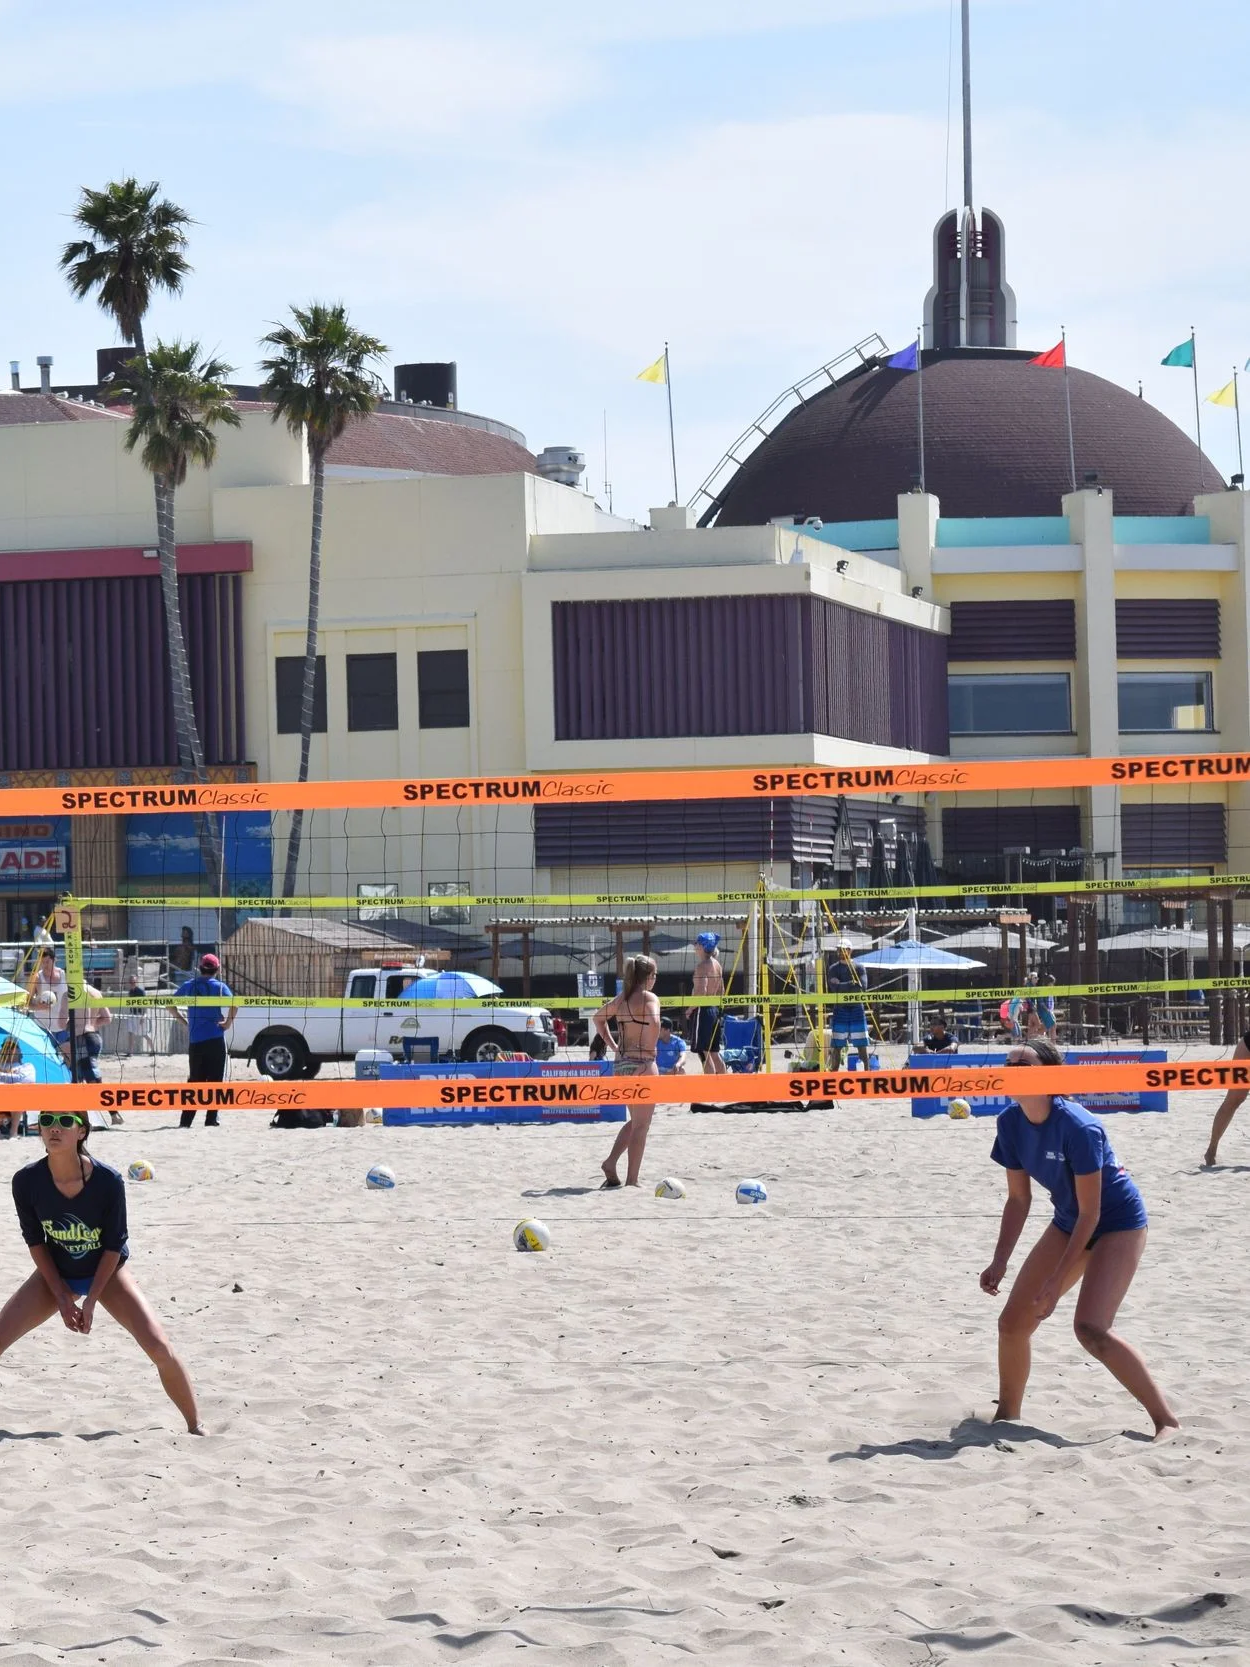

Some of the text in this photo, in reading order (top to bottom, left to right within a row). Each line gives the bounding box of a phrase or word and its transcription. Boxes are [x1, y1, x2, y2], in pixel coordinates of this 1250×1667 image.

[753, 769, 969, 790] SPECTRUM Classic
[403, 780, 615, 800] SPECTRUM Classic
[62, 789, 269, 809] SPECTRUM Classic
[1209, 874, 1250, 884] SPECTRU
[962, 885, 1011, 894] SPECTRUM
[1085, 881, 1135, 889] SPECTRUM
[839, 889, 888, 898] SPECTRUM
[356, 898, 404, 906] SPECTRUM
[476, 897, 524, 905] SPECTRUM
[596, 895, 645, 903] SPECTRUM
[1088, 985, 1138, 993] SPECTRUM
[844, 994, 893, 1002] SPECTRUM
[965, 990, 1014, 998] SPECTRUM
[126, 998, 173, 1006] SPECTRUM
[541, 1069, 578, 1077] CALIFORNIA
[1146, 1064, 1250, 1086] SPECTR
[789, 1075, 1004, 1096] SPECTRUM Classic
[100, 1089, 306, 1106] SPECTRUM Classic
[440, 1084, 651, 1103] SPECTRUM Classic
